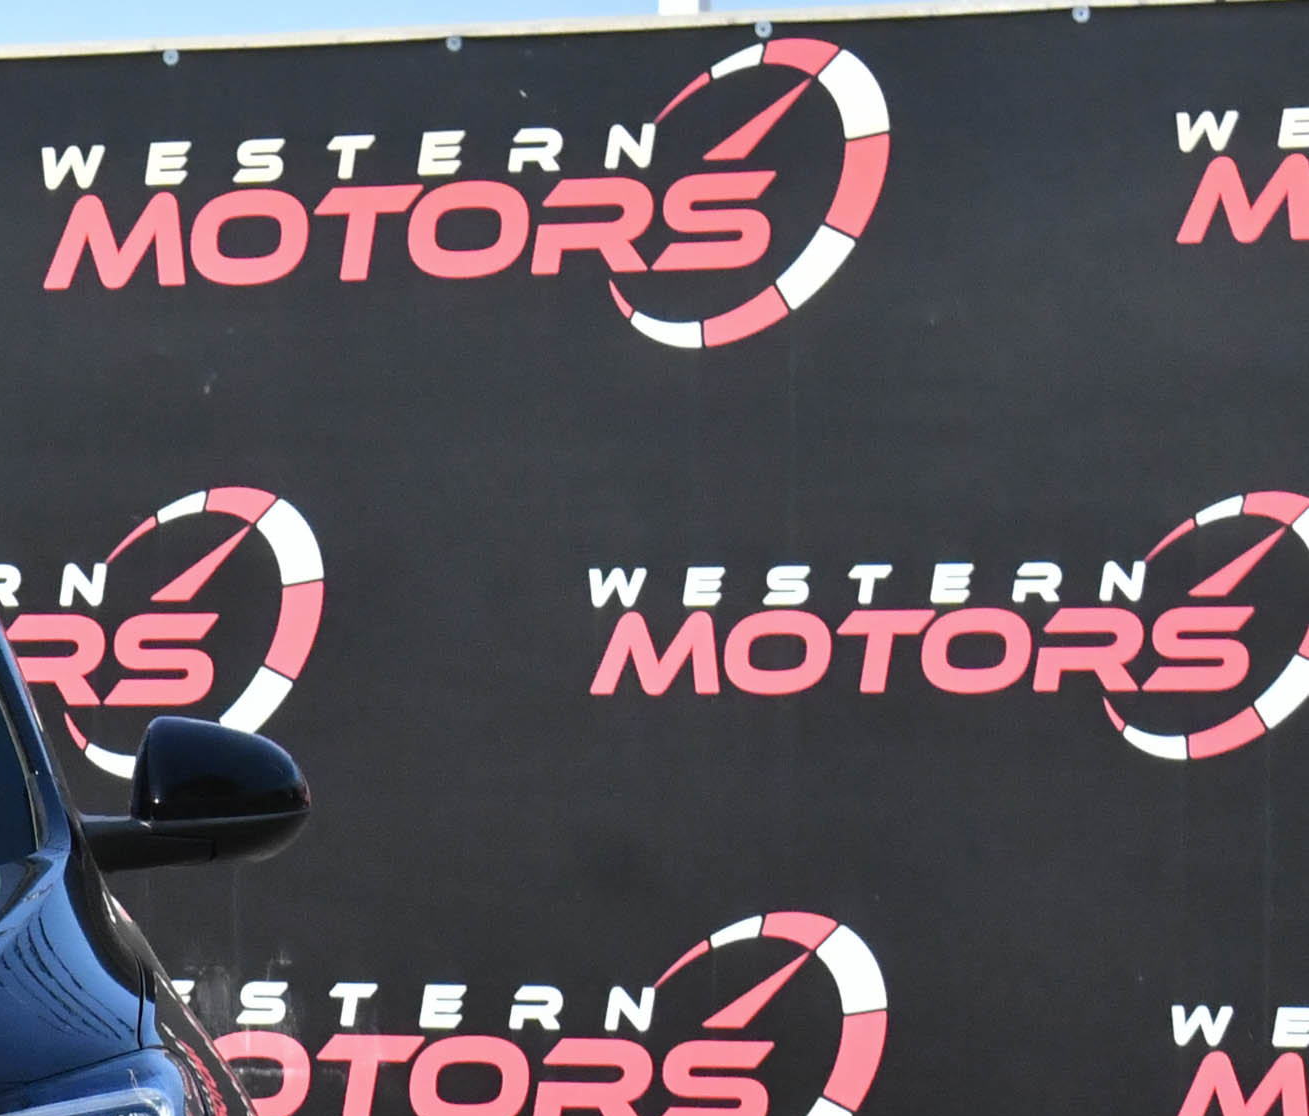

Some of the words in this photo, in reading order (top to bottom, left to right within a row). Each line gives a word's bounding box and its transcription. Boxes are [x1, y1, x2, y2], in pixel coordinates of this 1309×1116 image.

[40, 122, 657, 191] WESTERN
[42, 170, 778, 291] MOTORS
[588, 560, 1148, 608] WESTERN
[589, 605, 1255, 696] MOTORS
